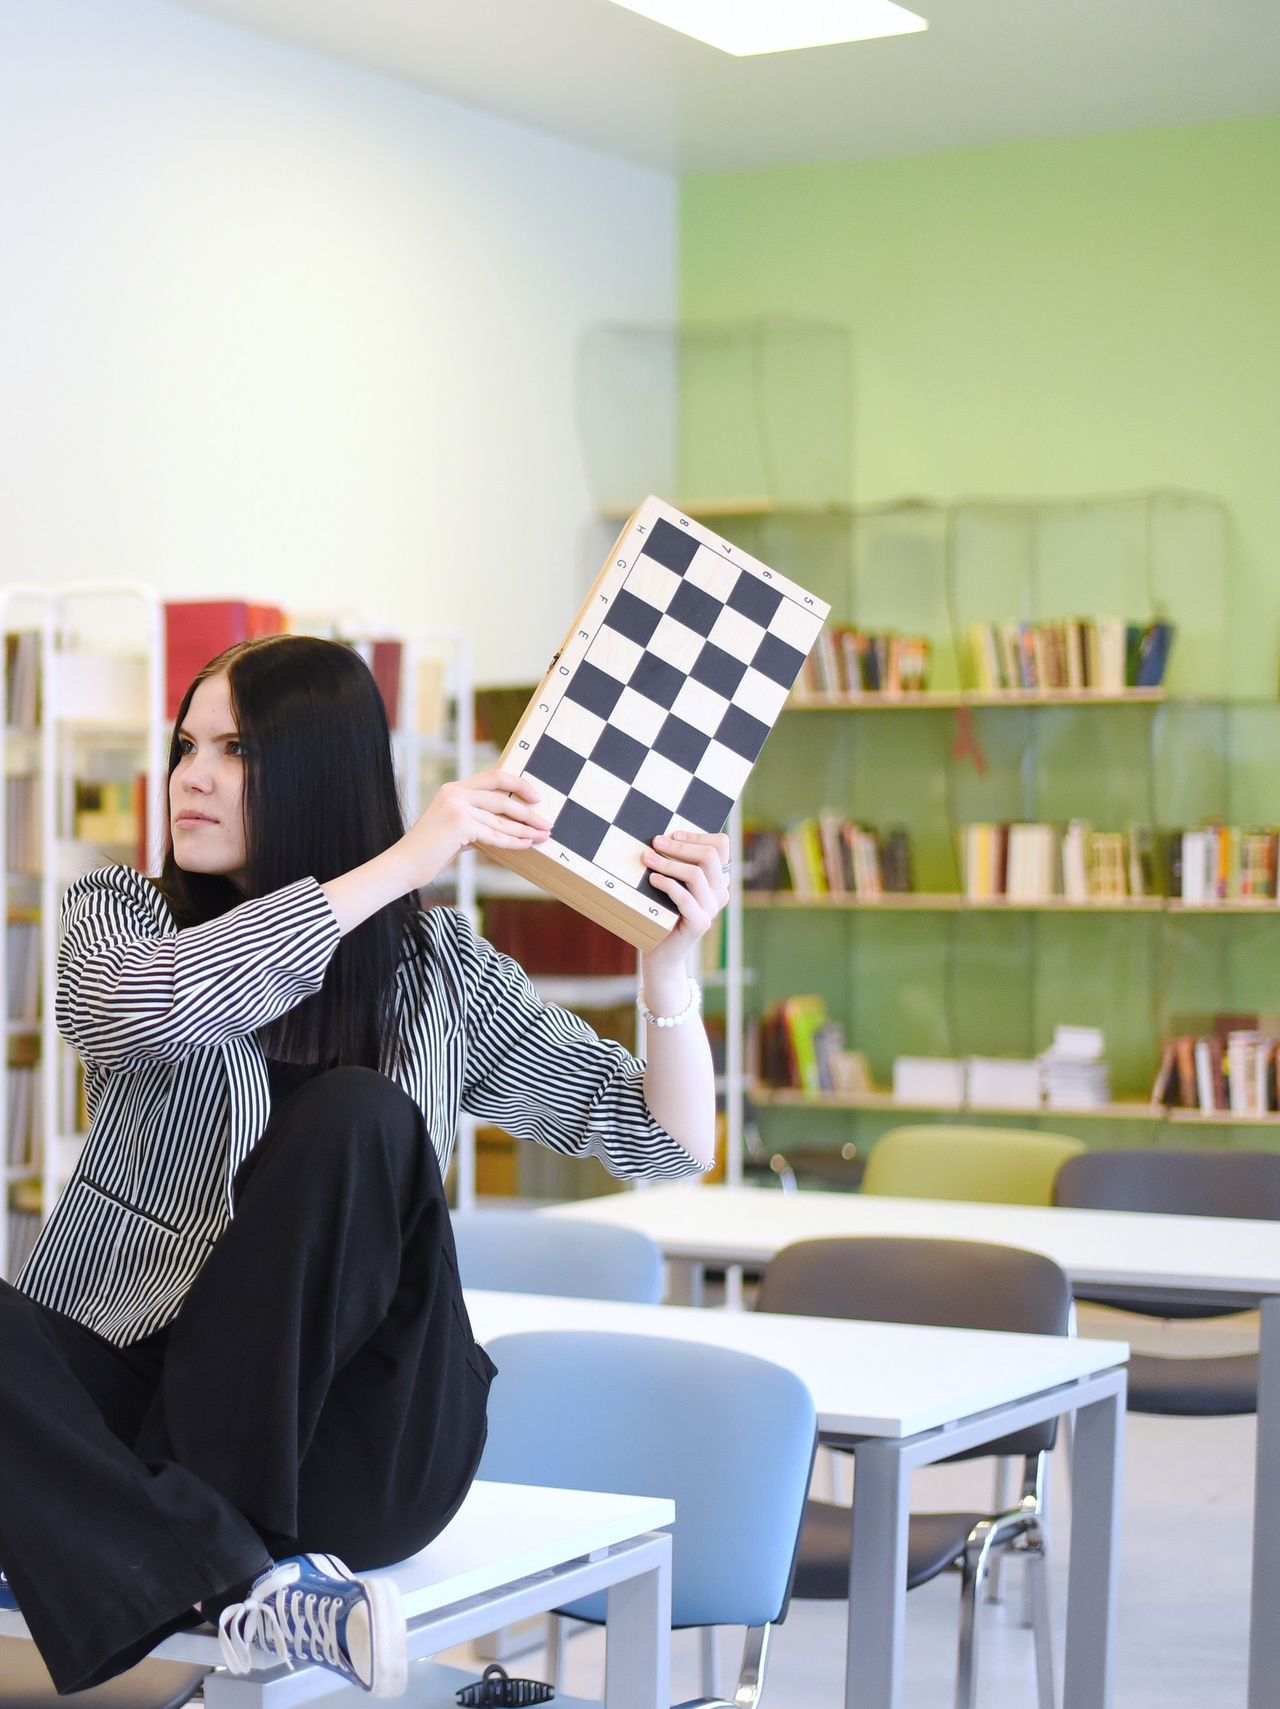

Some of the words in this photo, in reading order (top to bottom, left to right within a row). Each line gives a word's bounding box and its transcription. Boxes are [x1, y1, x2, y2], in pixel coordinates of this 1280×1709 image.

[636, 524, 646, 535] H
[616, 559, 627, 569] G
[679, 518, 690, 527] 8
[721, 544, 732, 554] 7
[762, 570, 772, 580] 6
[804, 596, 814, 606] 5
[599, 594, 609, 605] F
[578, 629, 589, 640] E
[558, 666, 570, 676] D
[539, 703, 549, 713] C
[518, 739, 530, 750] B
[559, 852, 570, 862] 7
[604, 880, 615, 889] 6
[648, 906, 659, 916] 5
